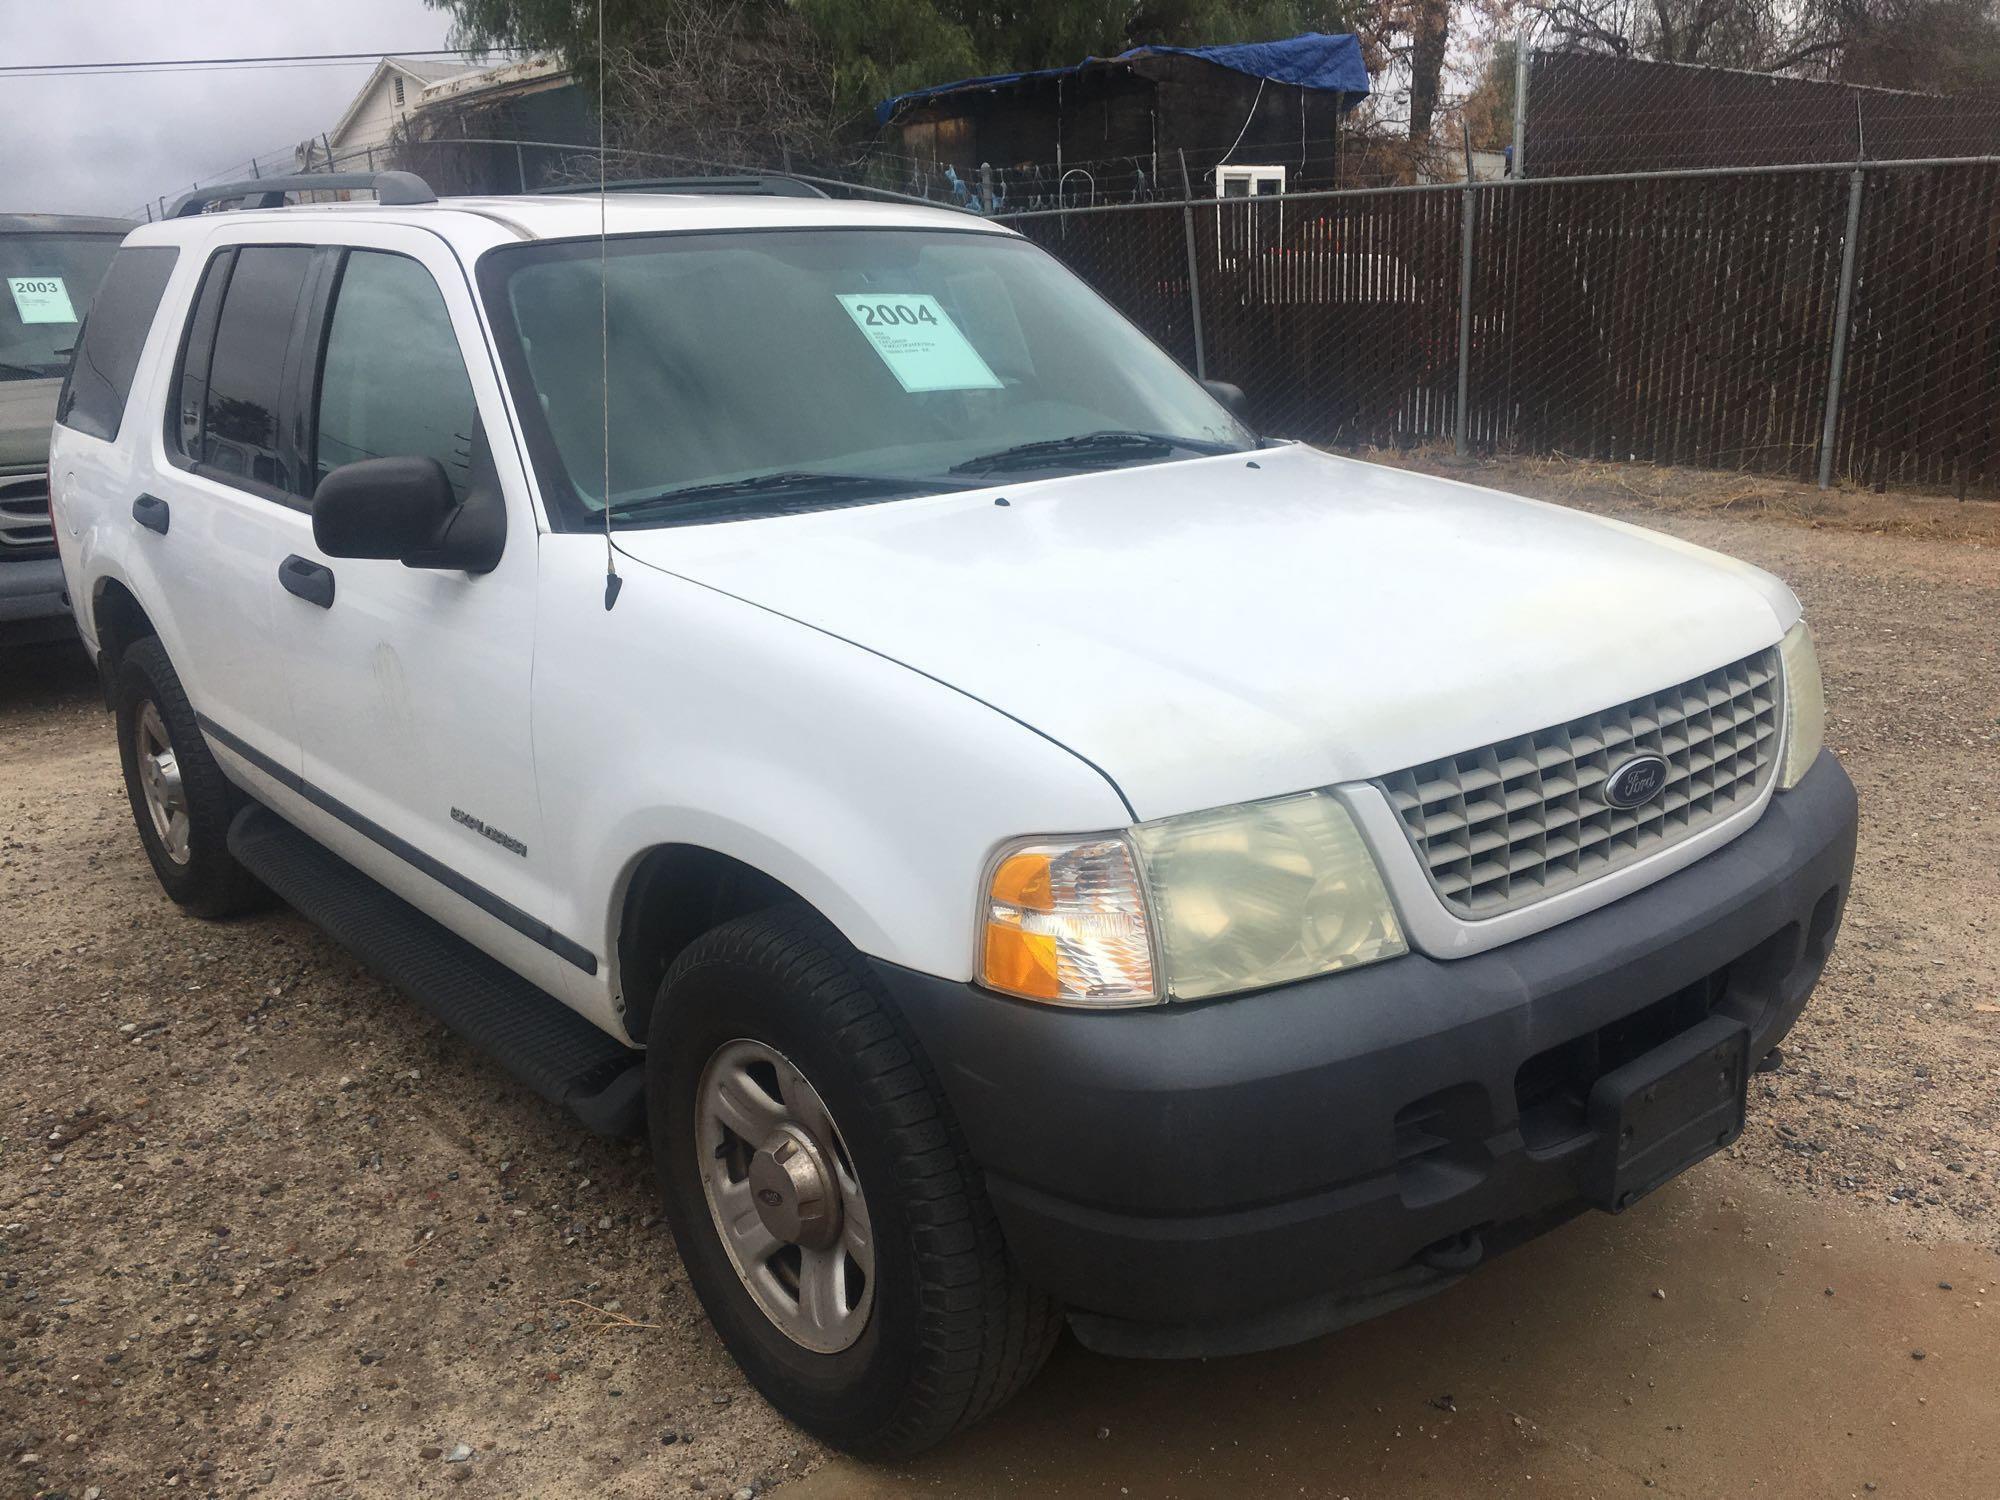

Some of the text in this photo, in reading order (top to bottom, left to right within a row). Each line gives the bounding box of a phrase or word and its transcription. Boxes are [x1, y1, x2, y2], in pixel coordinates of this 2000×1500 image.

[15, 281, 58, 293] 2003
[856, 304, 938, 326] 2004
[1625, 768, 1656, 797] Ford
[450, 805, 528, 858] EXPLORER
